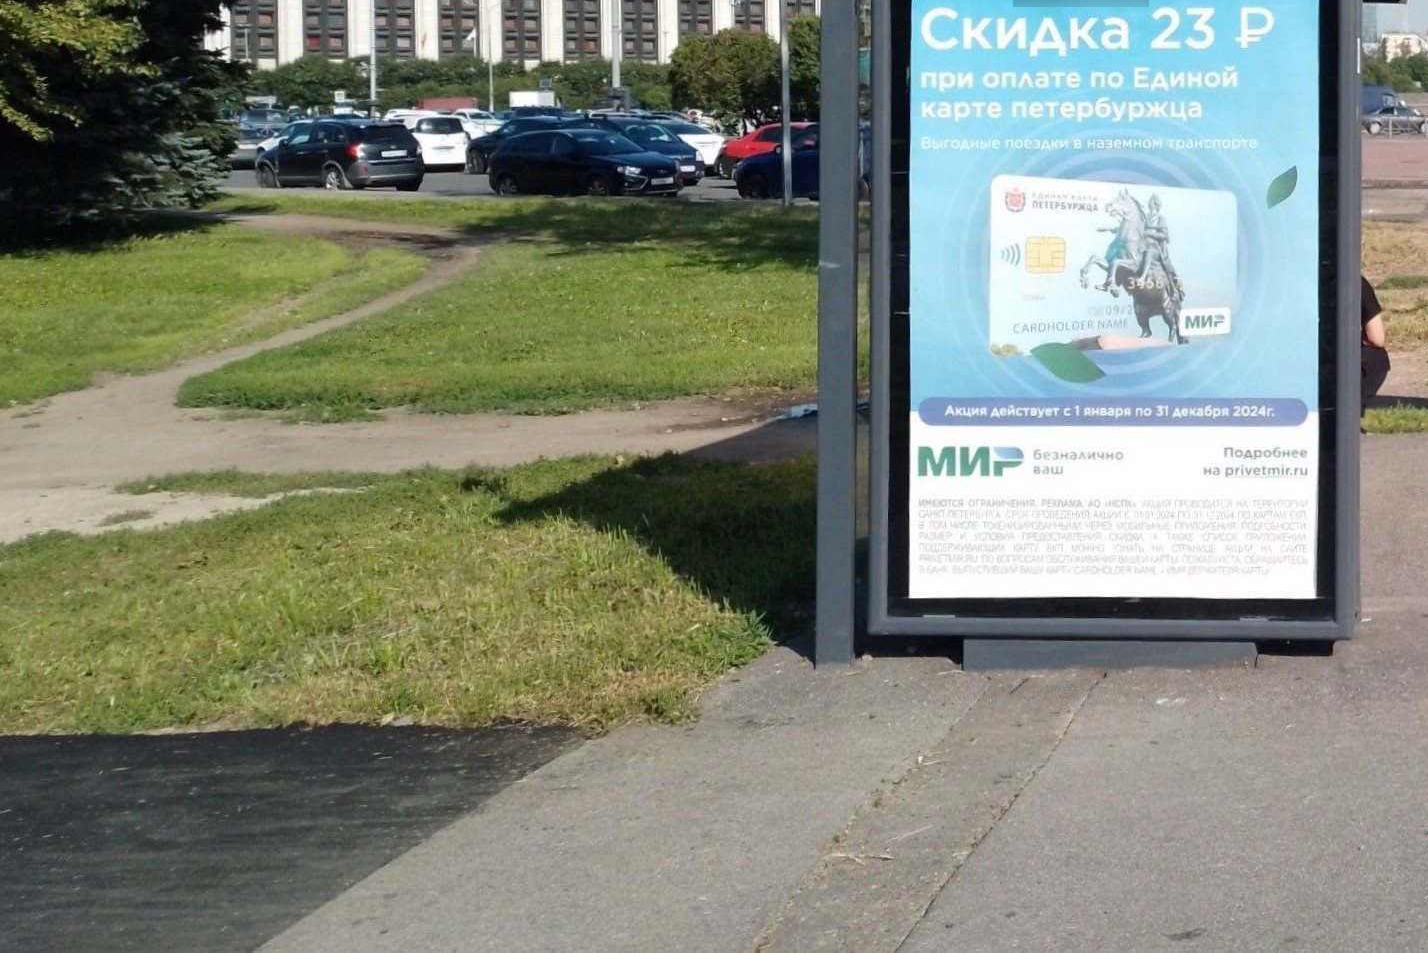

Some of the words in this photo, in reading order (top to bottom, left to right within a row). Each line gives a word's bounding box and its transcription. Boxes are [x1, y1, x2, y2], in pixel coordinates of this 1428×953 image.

[920, 7, 1130, 57] Скидка
[1150, 6, 1215, 50] 23
[920, 71, 974, 92] при
[982, 71, 1082, 89] оплате
[1089, 71, 1125, 89] по
[1133, 65, 1239, 92] Единой
[921, 101, 1003, 123] карте
[1011, 96, 1203, 123] петербуржца
[920, 136, 1001, 152] Выгодные
[1004, 137, 1070, 152] поездки
[1073, 138, 1083, 149] в
[1087, 136, 1165, 152] наземном
[1166, 137, 1259, 152] транспорте
[1031, 200, 1099, 213] ПЕТЕРБУРЖЦА
[1012, 322, 1095, 334] CARDHOLDER
[1097, 318, 1129, 329] NAME
[1184, 313, 1226, 330] МИР
[944, 404, 988, 418] Акция
[990, 404, 1060, 419] действует
[1062, 407, 1072, 417] с
[1074, 404, 1080, 417] 1
[1083, 406, 1132, 419] января
[1134, 407, 1153, 417] по
[1155, 404, 1169, 417] 31
[1171, 404, 1230, 419] декабря
[1232, 405, 1275, 417] 2024г.
[917, 445, 1024, 477] МИР
[1032, 448, 1124, 461] безналично
[1223, 446, 1308, 461] Подробнее
[1032, 465, 1064, 475] ваш
[1203, 466, 1221, 477] на
[1224, 464, 1308, 478] privetmir.ru
